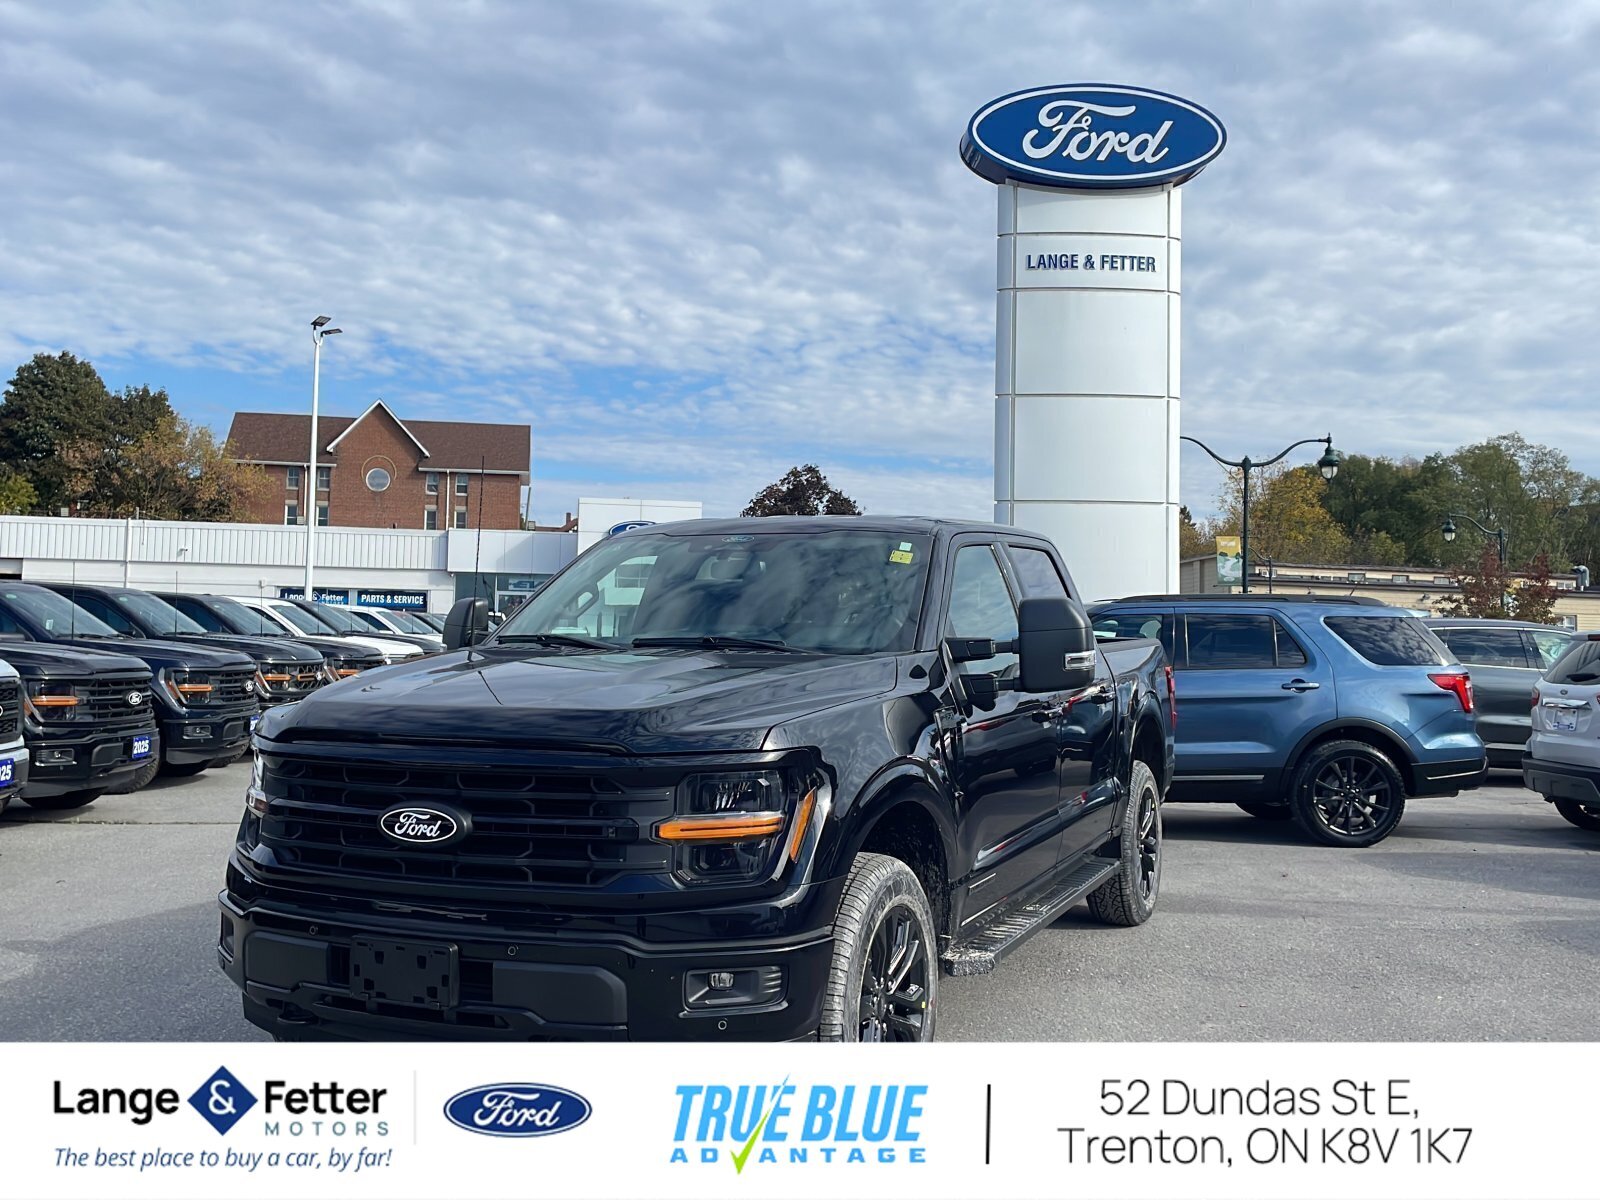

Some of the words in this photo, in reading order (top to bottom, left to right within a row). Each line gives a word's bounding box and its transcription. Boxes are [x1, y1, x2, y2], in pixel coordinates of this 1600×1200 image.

[1022, 100, 1173, 164] Ford
[1026, 253, 1079, 271] LANGE
[1083, 254, 1096, 271] &
[1099, 254, 1157, 273] FETTER
[321, 593, 345, 601] Fetter
[361, 594, 385, 604] PARTS
[386, 595, 392, 604] &
[393, 595, 424, 605] SERVICE
[133, 739, 149, 755] 2025
[0, 764, 12, 781] 25
[394, 811, 442, 838] Ford
